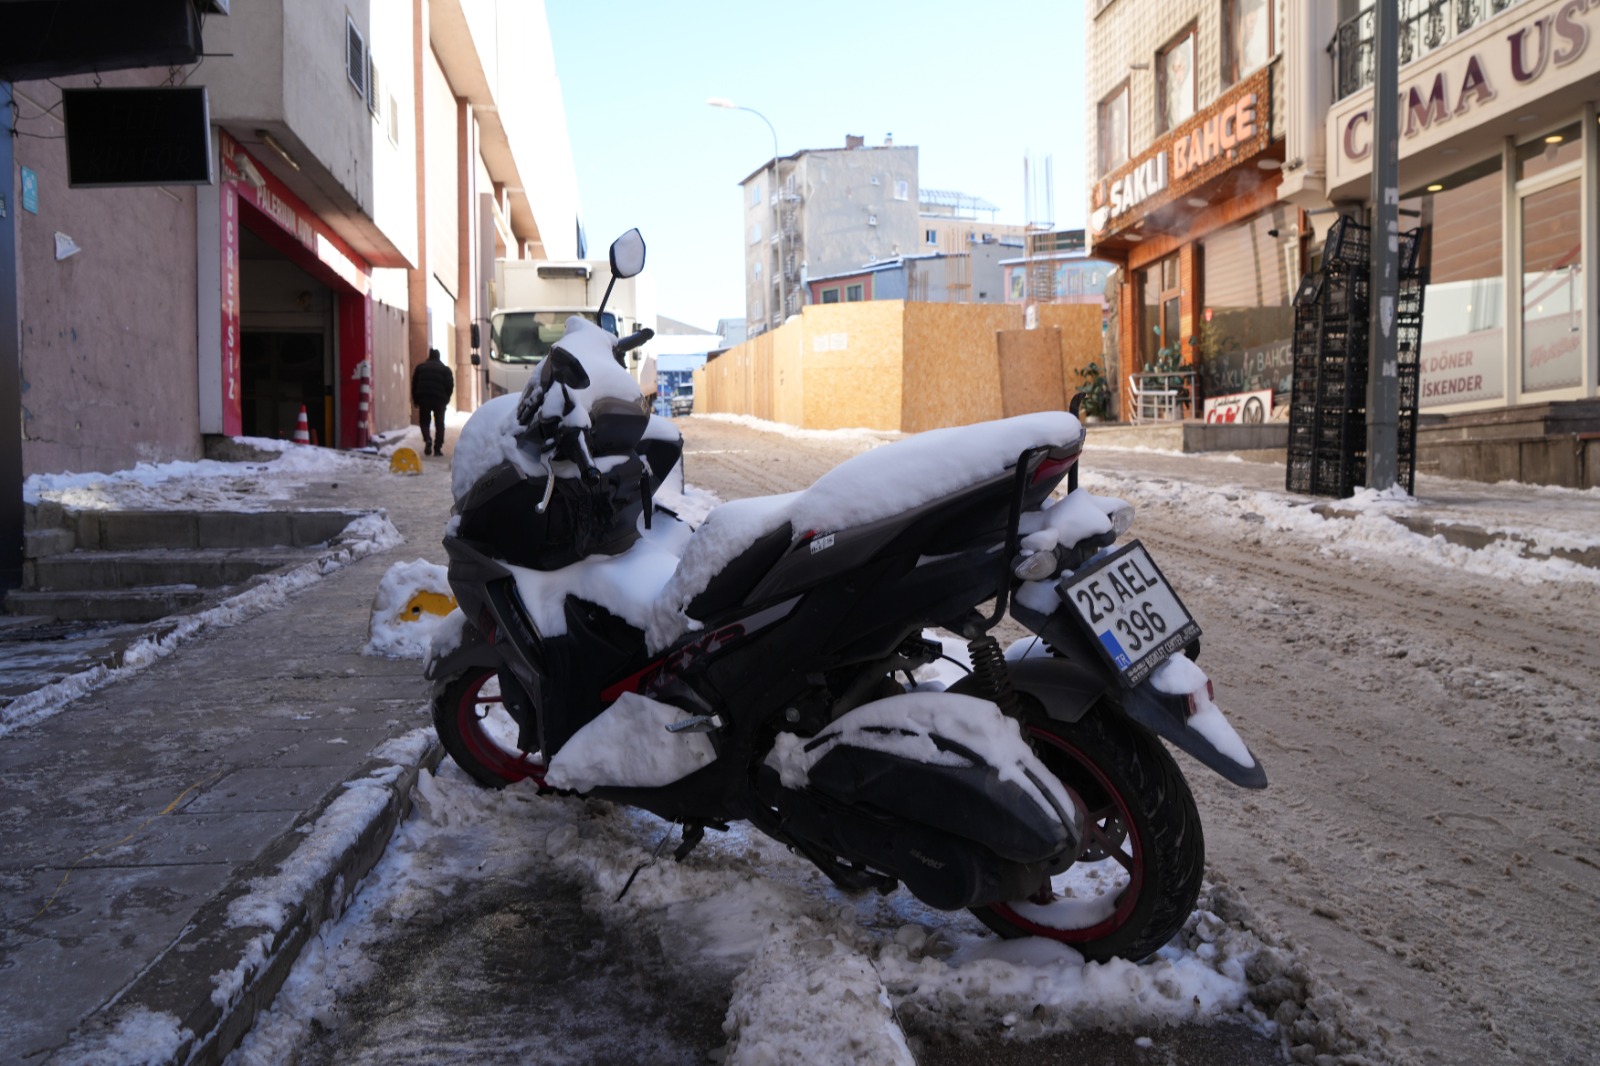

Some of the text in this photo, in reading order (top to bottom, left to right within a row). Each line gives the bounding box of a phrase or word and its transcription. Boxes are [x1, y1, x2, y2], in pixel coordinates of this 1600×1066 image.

[1343, 53, 1496, 160] CMA
[1110, 94, 1257, 217] SAKLI BAHÇE
[1422, 375, 1482, 398] İSKENDER
[1430, 350, 1473, 373] DÖNER
[1077, 558, 1159, 624] 25 AEL
[1116, 601, 1167, 651] 396
[1115, 656, 1131, 668] TR
